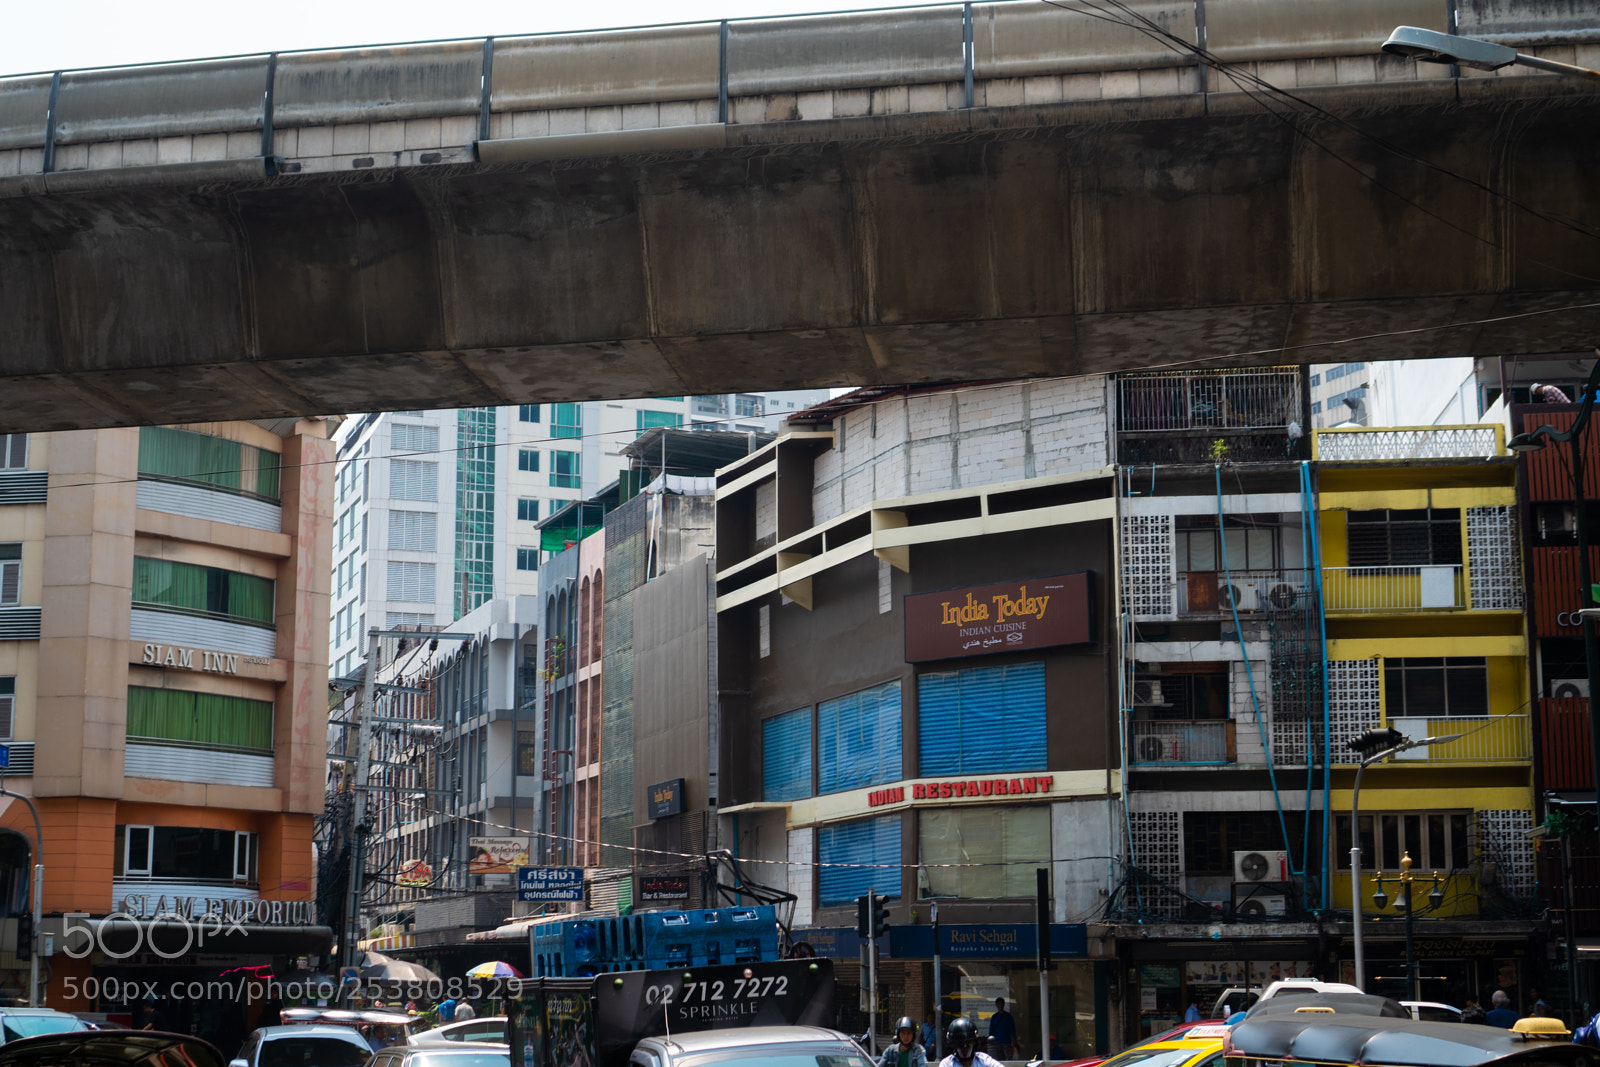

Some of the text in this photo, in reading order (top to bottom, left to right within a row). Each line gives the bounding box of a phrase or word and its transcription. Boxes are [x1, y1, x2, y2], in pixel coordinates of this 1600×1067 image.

[941, 585, 1050, 627] India Today
[959, 621, 1027, 637] INDIAN CUISINE
[143, 643, 239, 675] SIAM INN
[867, 775, 1054, 807] INDIAN RESTAURANT
[527, 868, 575, 880] ศรีสง่า
[124, 894, 316, 925] SIAM EMPORIUM
[951, 929, 1017, 946] Ravi Sehgal
[645, 975, 788, 1005] 02 712 7272
[679, 1001, 758, 1020] SPRINKLE
